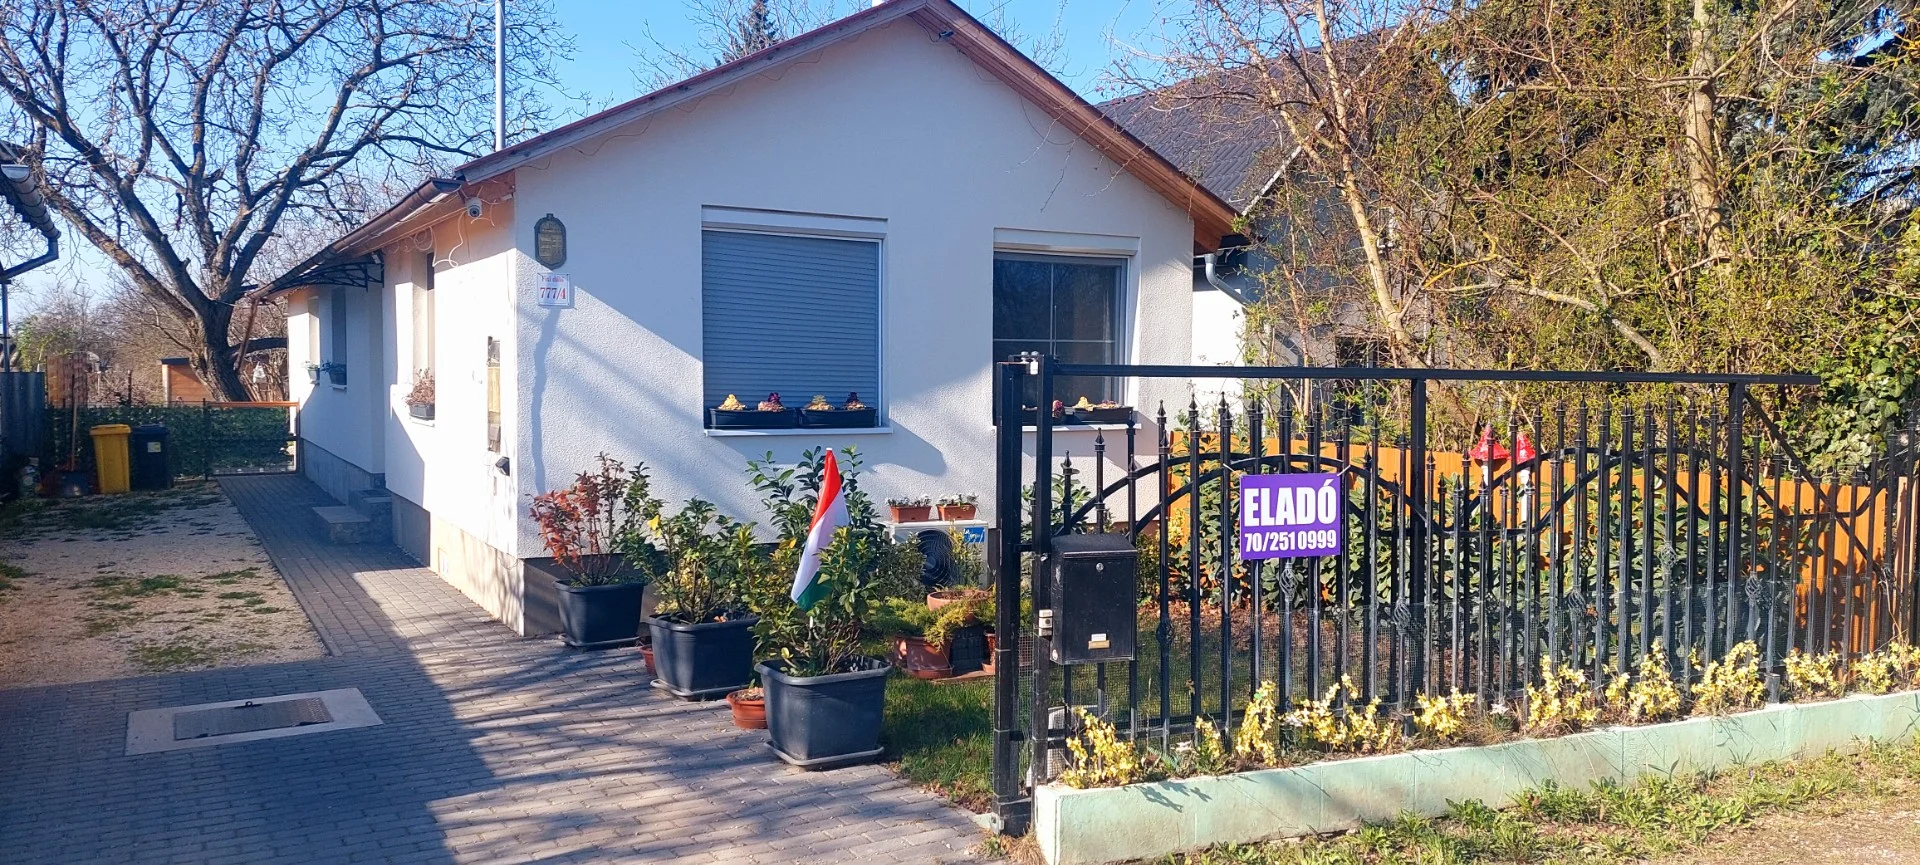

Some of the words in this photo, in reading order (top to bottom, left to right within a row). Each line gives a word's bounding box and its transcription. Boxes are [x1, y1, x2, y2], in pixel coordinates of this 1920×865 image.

[540, 287, 566, 300] 777/4
[1244, 479, 1337, 527] ELADÓ
[1244, 532, 1296, 553] 70/251
[1297, 529, 1337, 550] 0999
